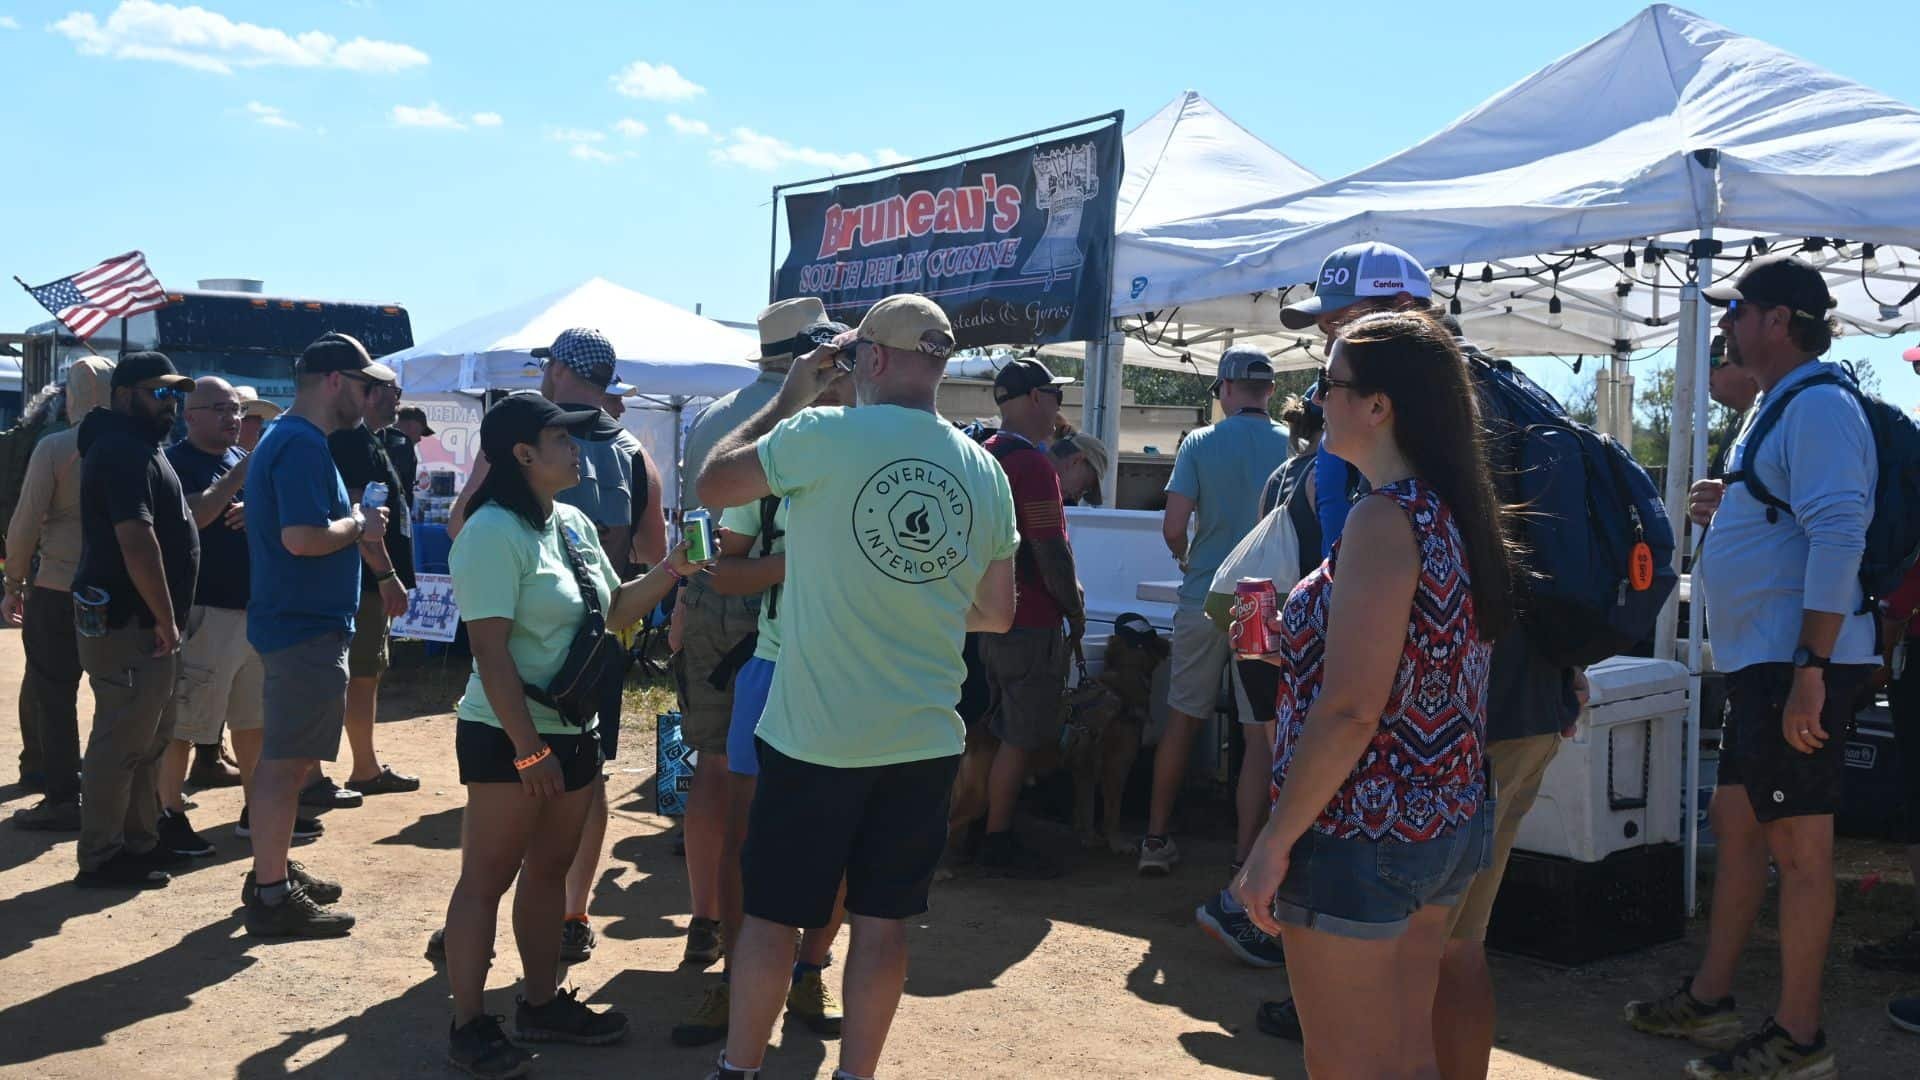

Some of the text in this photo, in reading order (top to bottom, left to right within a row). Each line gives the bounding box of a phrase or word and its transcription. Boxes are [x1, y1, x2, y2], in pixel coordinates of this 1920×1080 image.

[816, 173, 1022, 260] Bruneau's
[799, 237, 1022, 293] SOUTH PHILLY CUISINE
[1321, 267, 1350, 286] 50
[951, 298, 995, 331] steaks
[1025, 299, 1073, 336] Gyros
[876, 467, 964, 516] OVERLAND
[865, 528, 958, 574] INTERIORS
